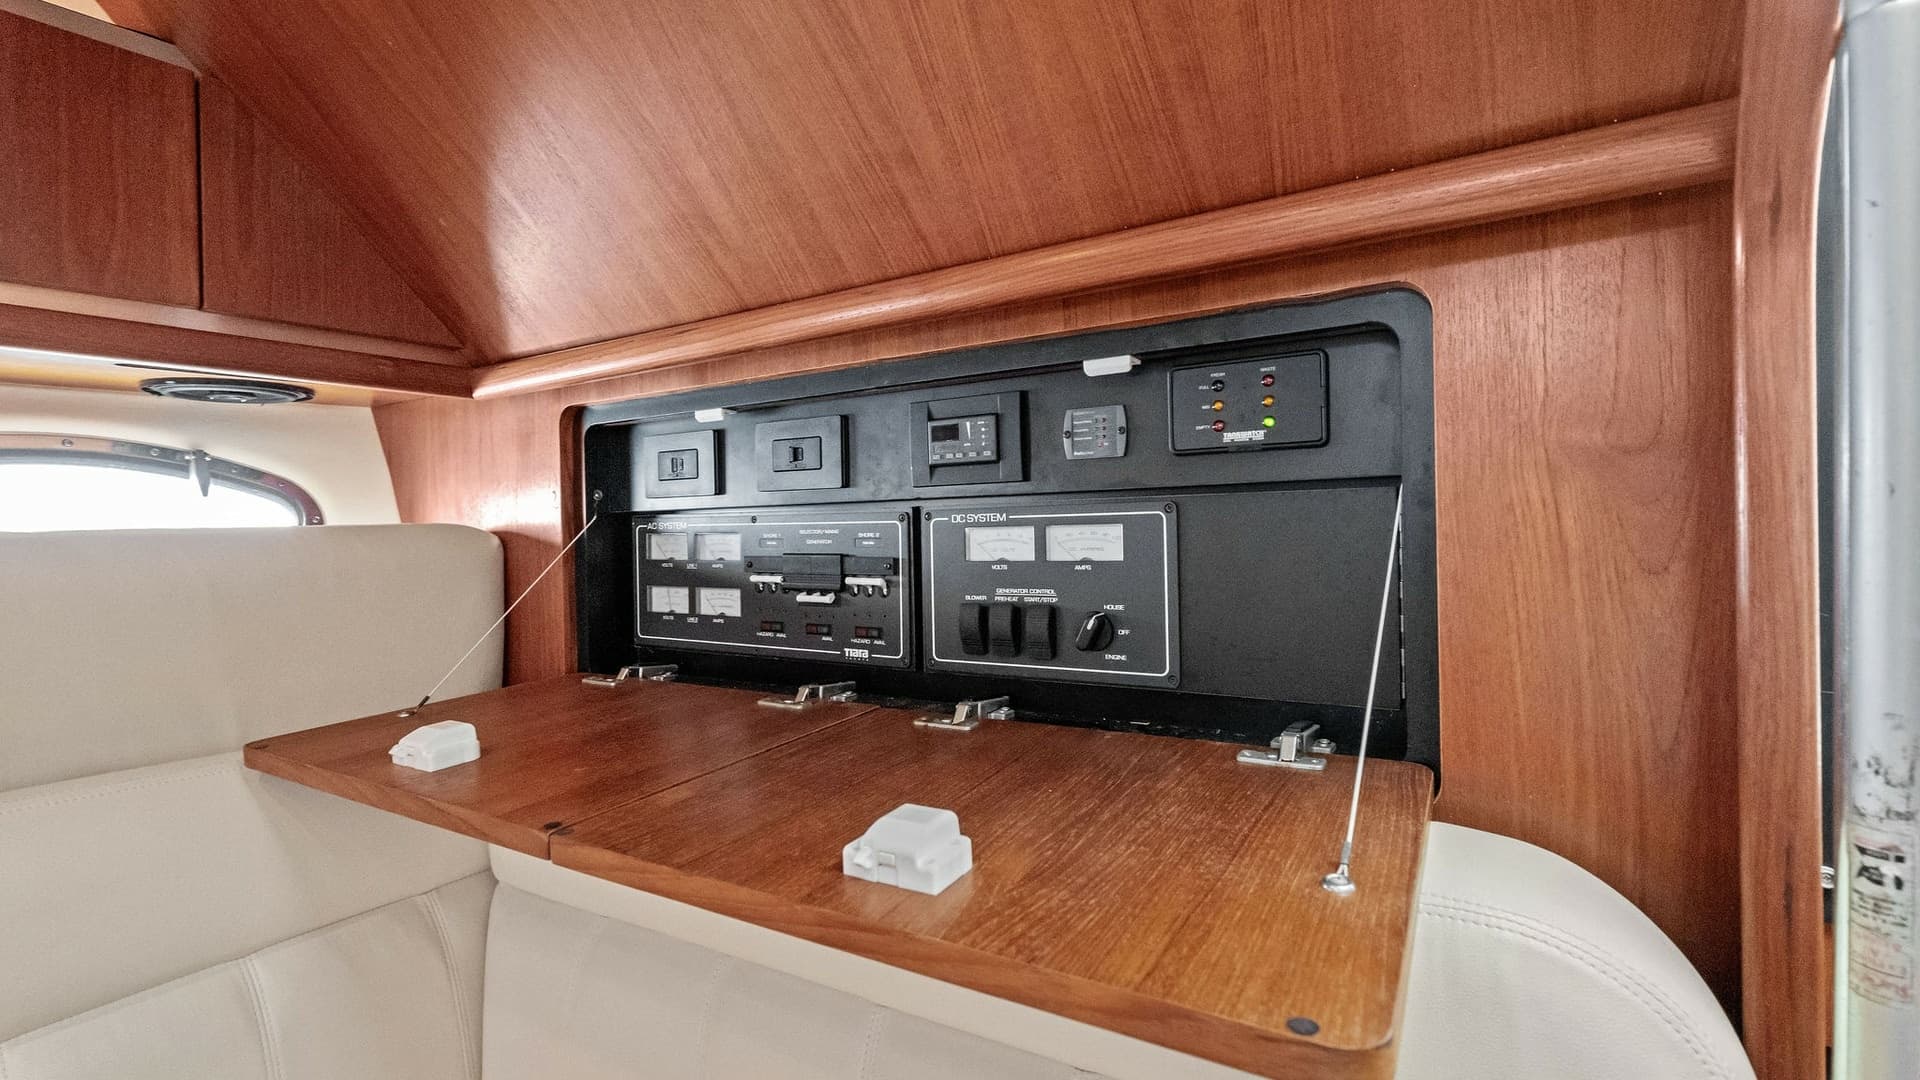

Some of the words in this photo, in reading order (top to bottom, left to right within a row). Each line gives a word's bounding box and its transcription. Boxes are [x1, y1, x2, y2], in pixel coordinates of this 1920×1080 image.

[951, 514, 966, 523] DC
[967, 513, 1007, 523] SYSTEM
[658, 522, 688, 530] SYSTEM
